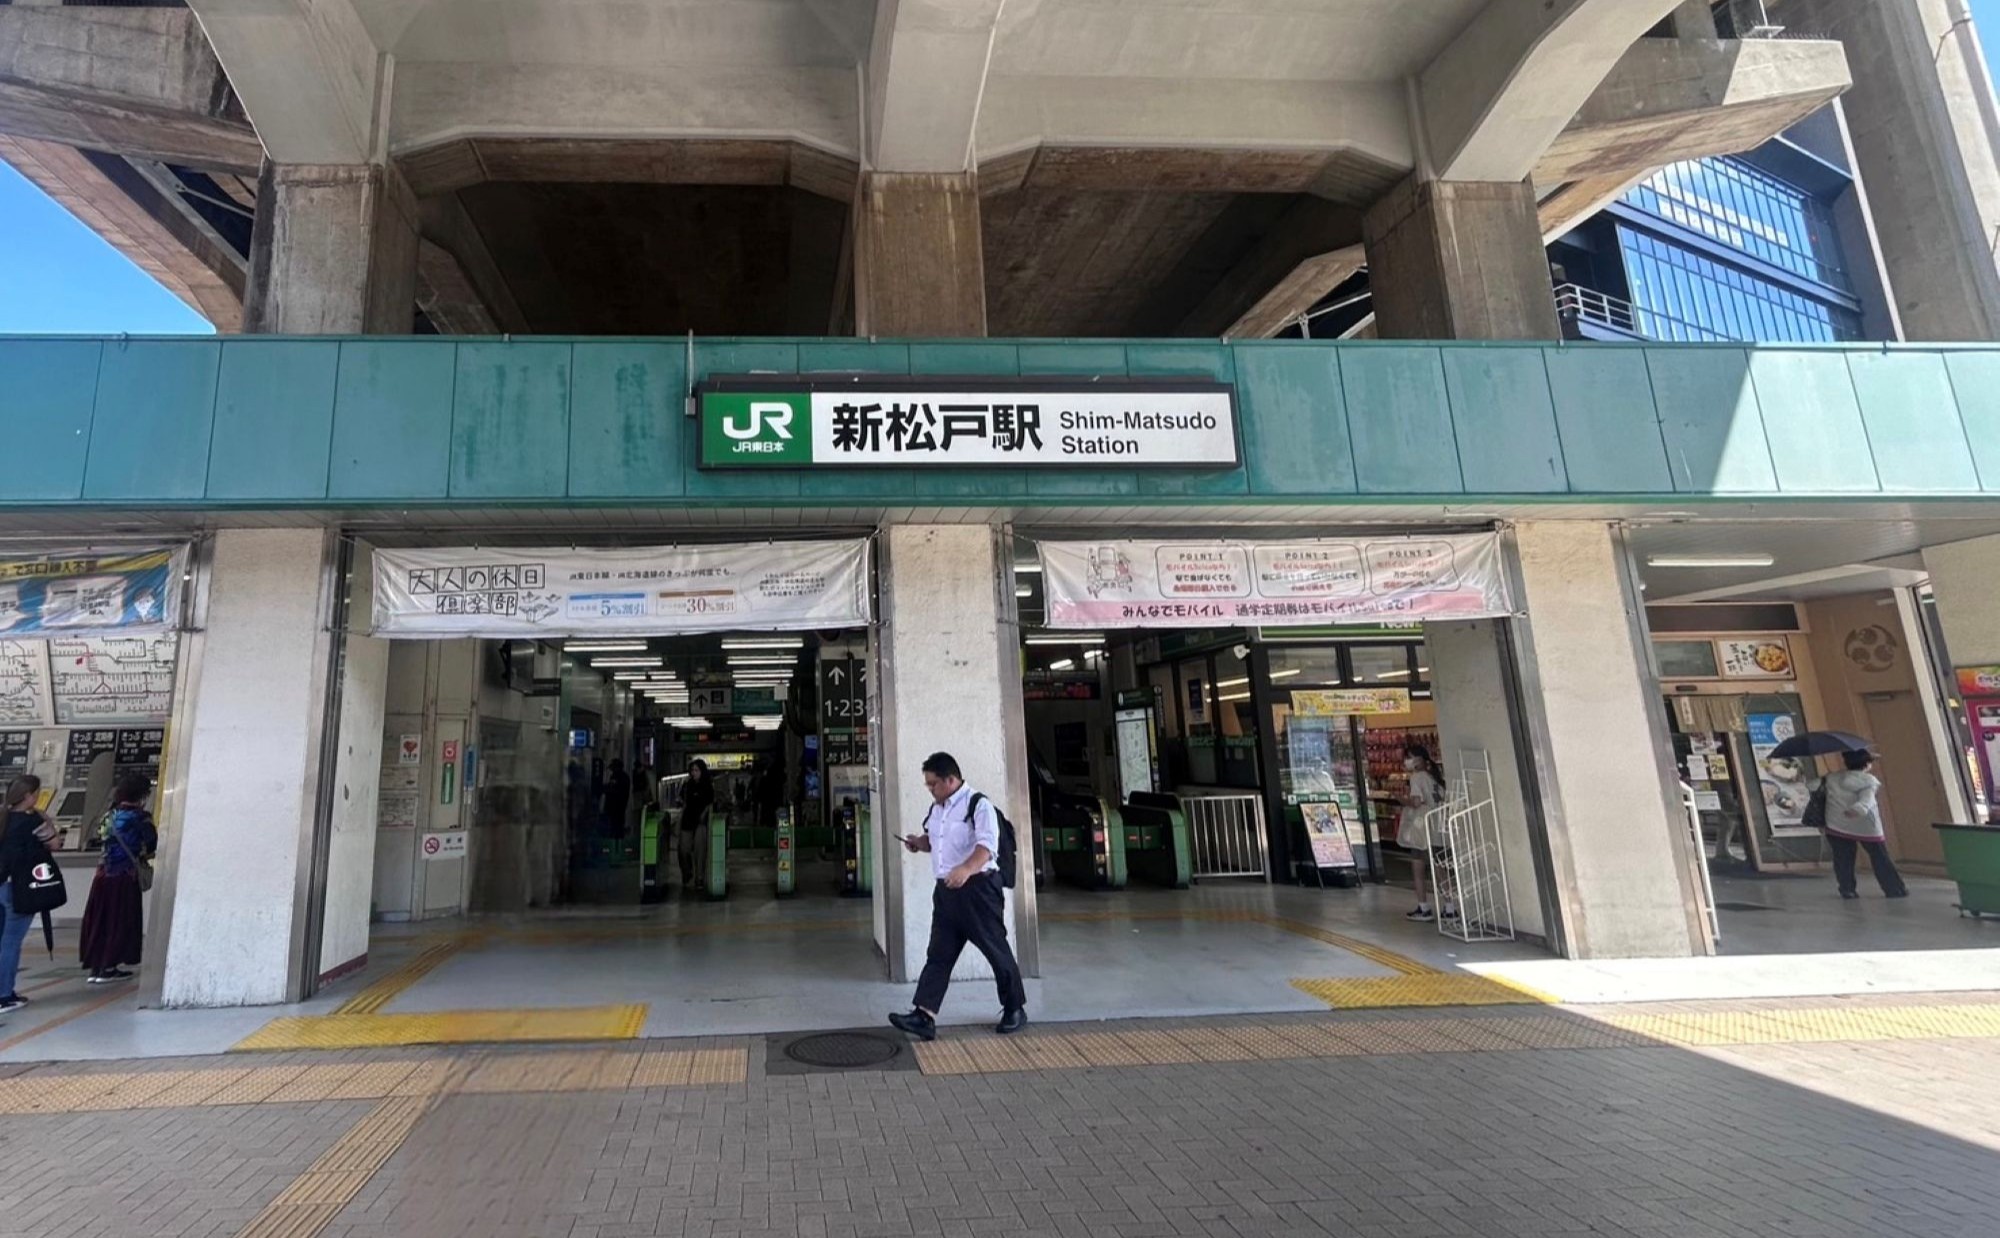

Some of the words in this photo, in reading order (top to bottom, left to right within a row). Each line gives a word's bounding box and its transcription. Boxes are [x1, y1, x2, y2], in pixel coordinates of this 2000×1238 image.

[723, 402, 793, 439] JR
[832, 403, 1043, 452] 新松戸駅
[732, 441, 784, 453] JR東日本
[1061, 435, 1139, 454] Station
[1122, 604, 1224, 617] みんなでモバイル
